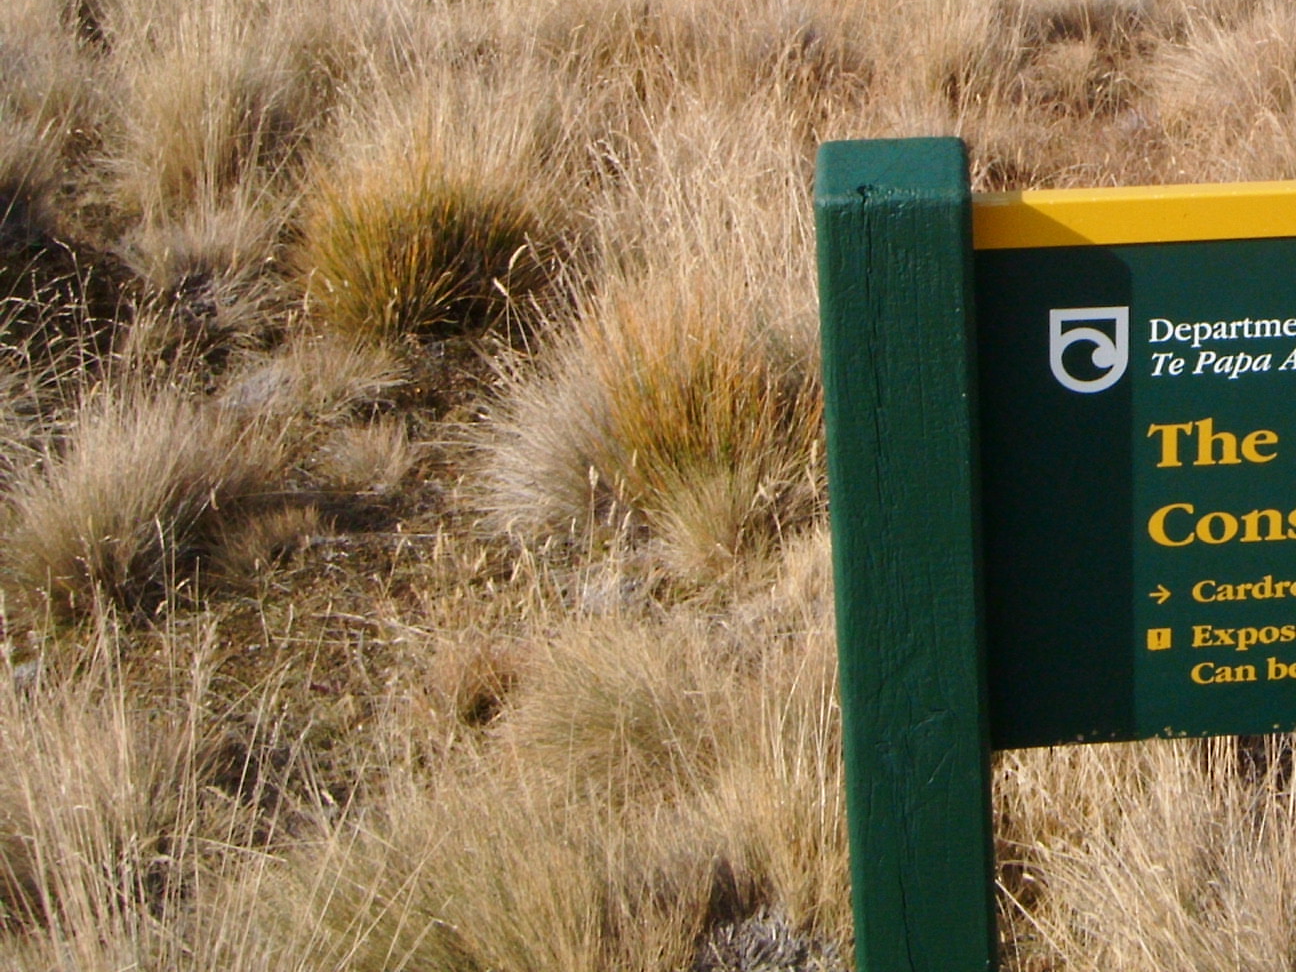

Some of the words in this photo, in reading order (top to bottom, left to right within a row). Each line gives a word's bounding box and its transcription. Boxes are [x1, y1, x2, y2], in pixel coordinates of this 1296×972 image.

[1152, 352, 1184, 376] Te
[1192, 351, 1272, 379] Papa
[1148, 418, 1278, 467] The
[1191, 662, 1256, 684] Can
